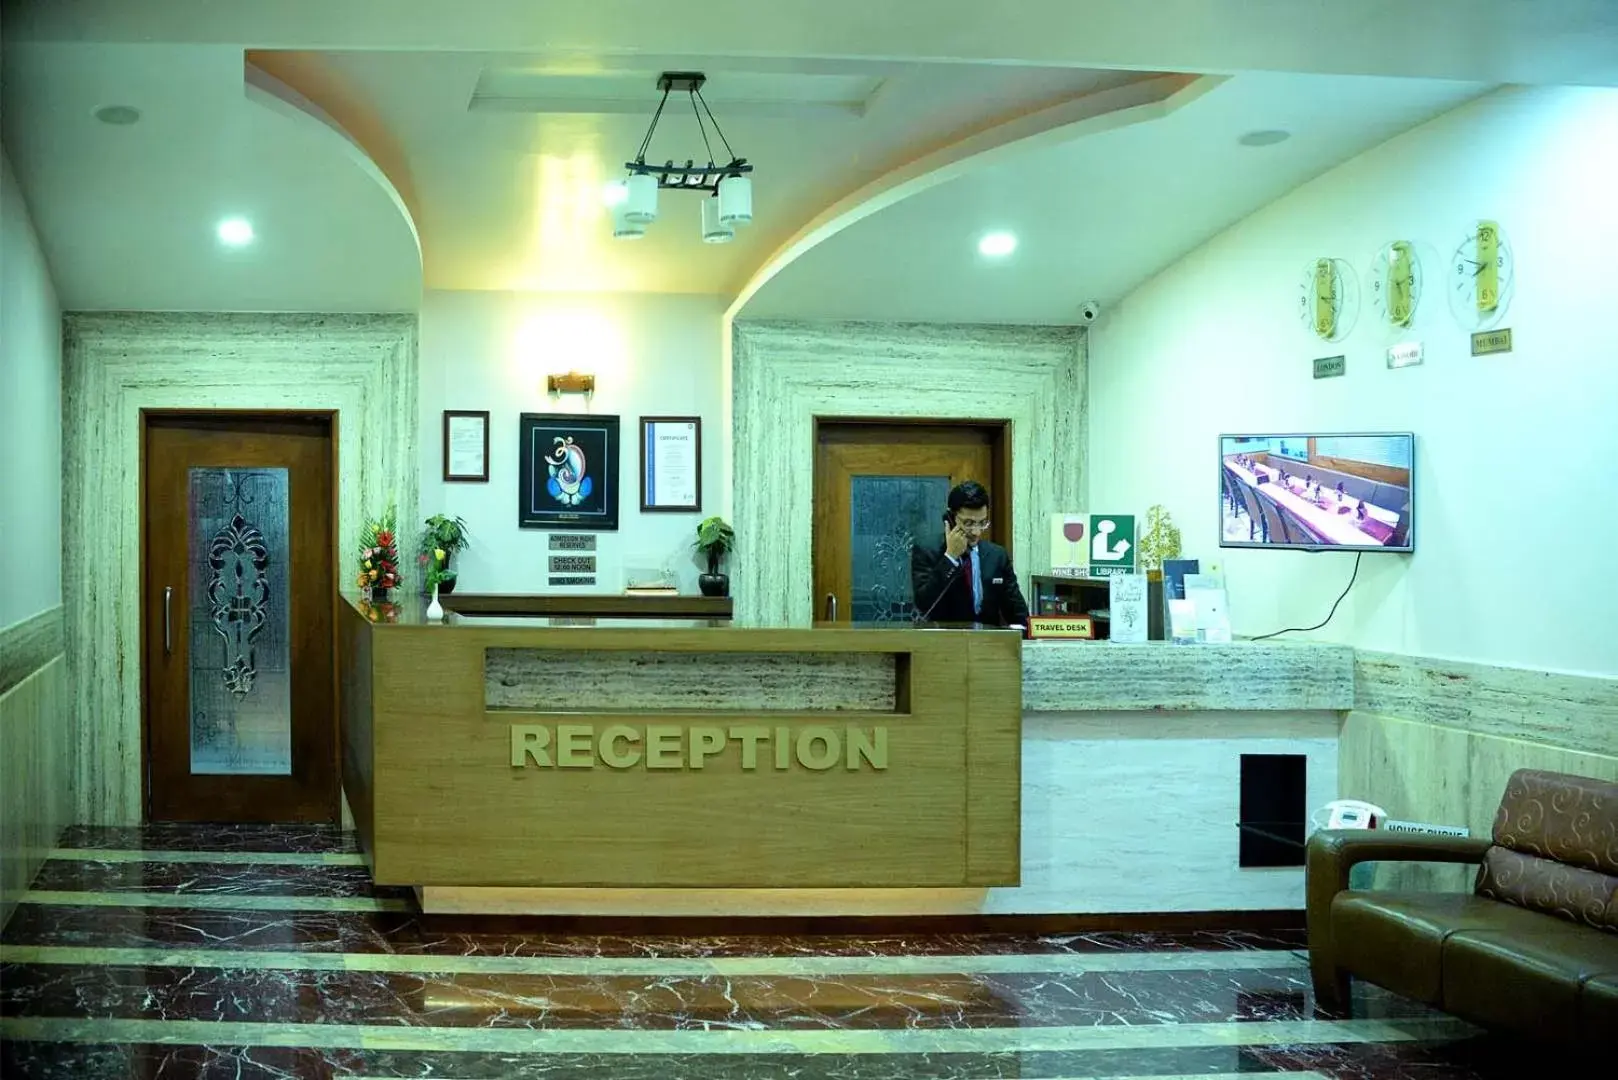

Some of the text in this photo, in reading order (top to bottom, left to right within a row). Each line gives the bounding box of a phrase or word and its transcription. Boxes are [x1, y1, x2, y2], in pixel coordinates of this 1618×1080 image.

[1052, 567, 1072, 577] WINE
[1096, 567, 1127, 576] LIBRARY
[510, 724, 889, 771] RECEPTION
